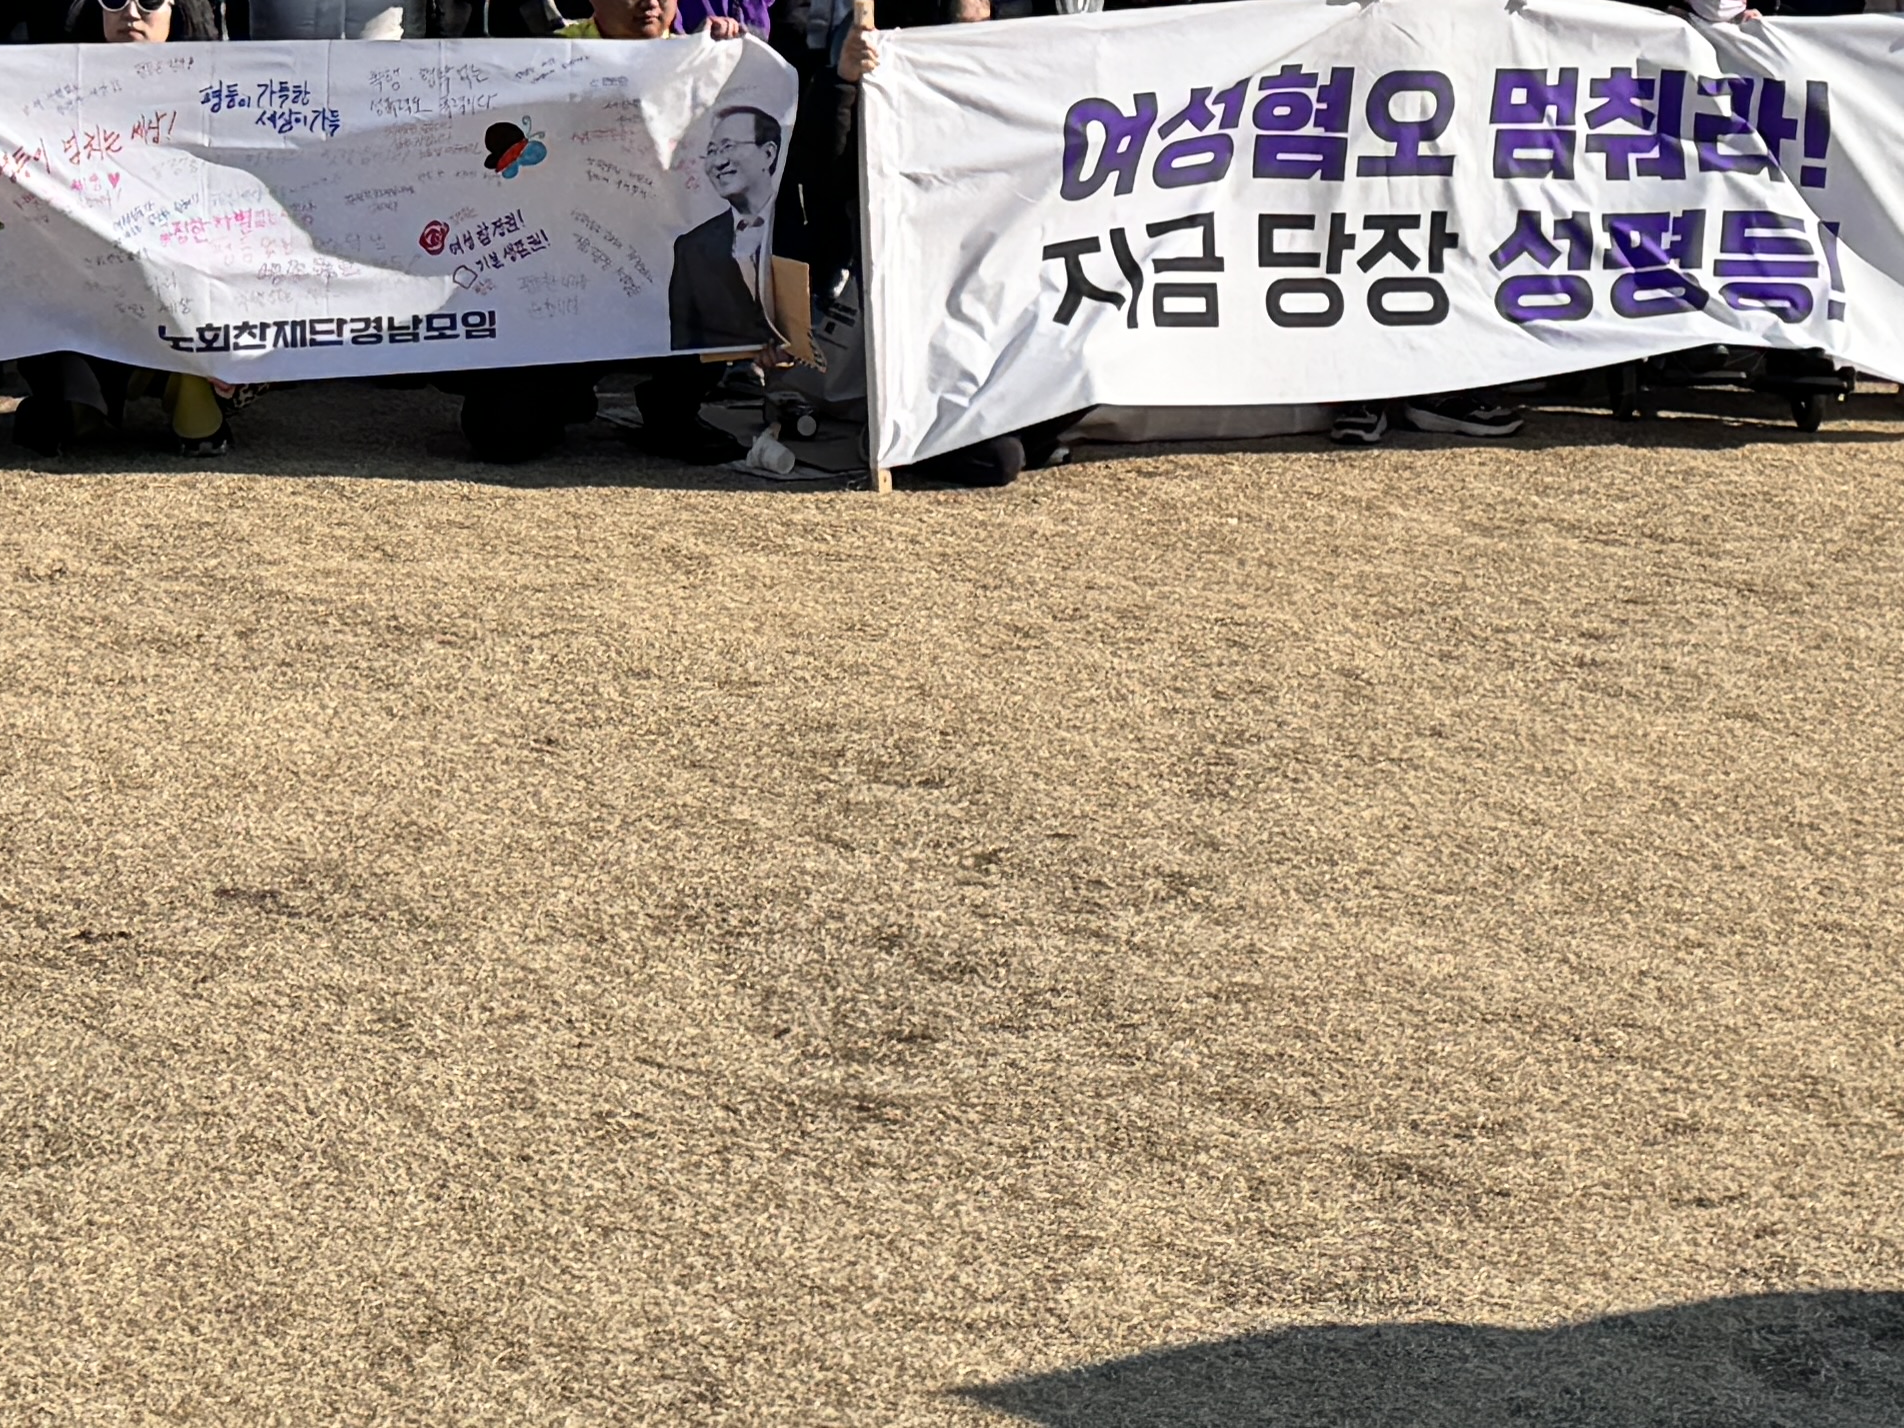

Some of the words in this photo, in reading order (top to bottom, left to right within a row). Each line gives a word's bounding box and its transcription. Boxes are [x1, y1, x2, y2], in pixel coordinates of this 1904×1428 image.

[199, 83, 251, 114] 평등이
[256, 79, 311, 107] 가득한
[1060, 64, 1458, 201] 여성혐오
[1489, 68, 1832, 191] 멈춰라!
[1042, 213, 1224, 329] 지금
[1257, 210, 1459, 328] 당장
[1489, 206, 1848, 325] 성평등!
[158, 310, 497, 353] 노회찬재단경남모임
